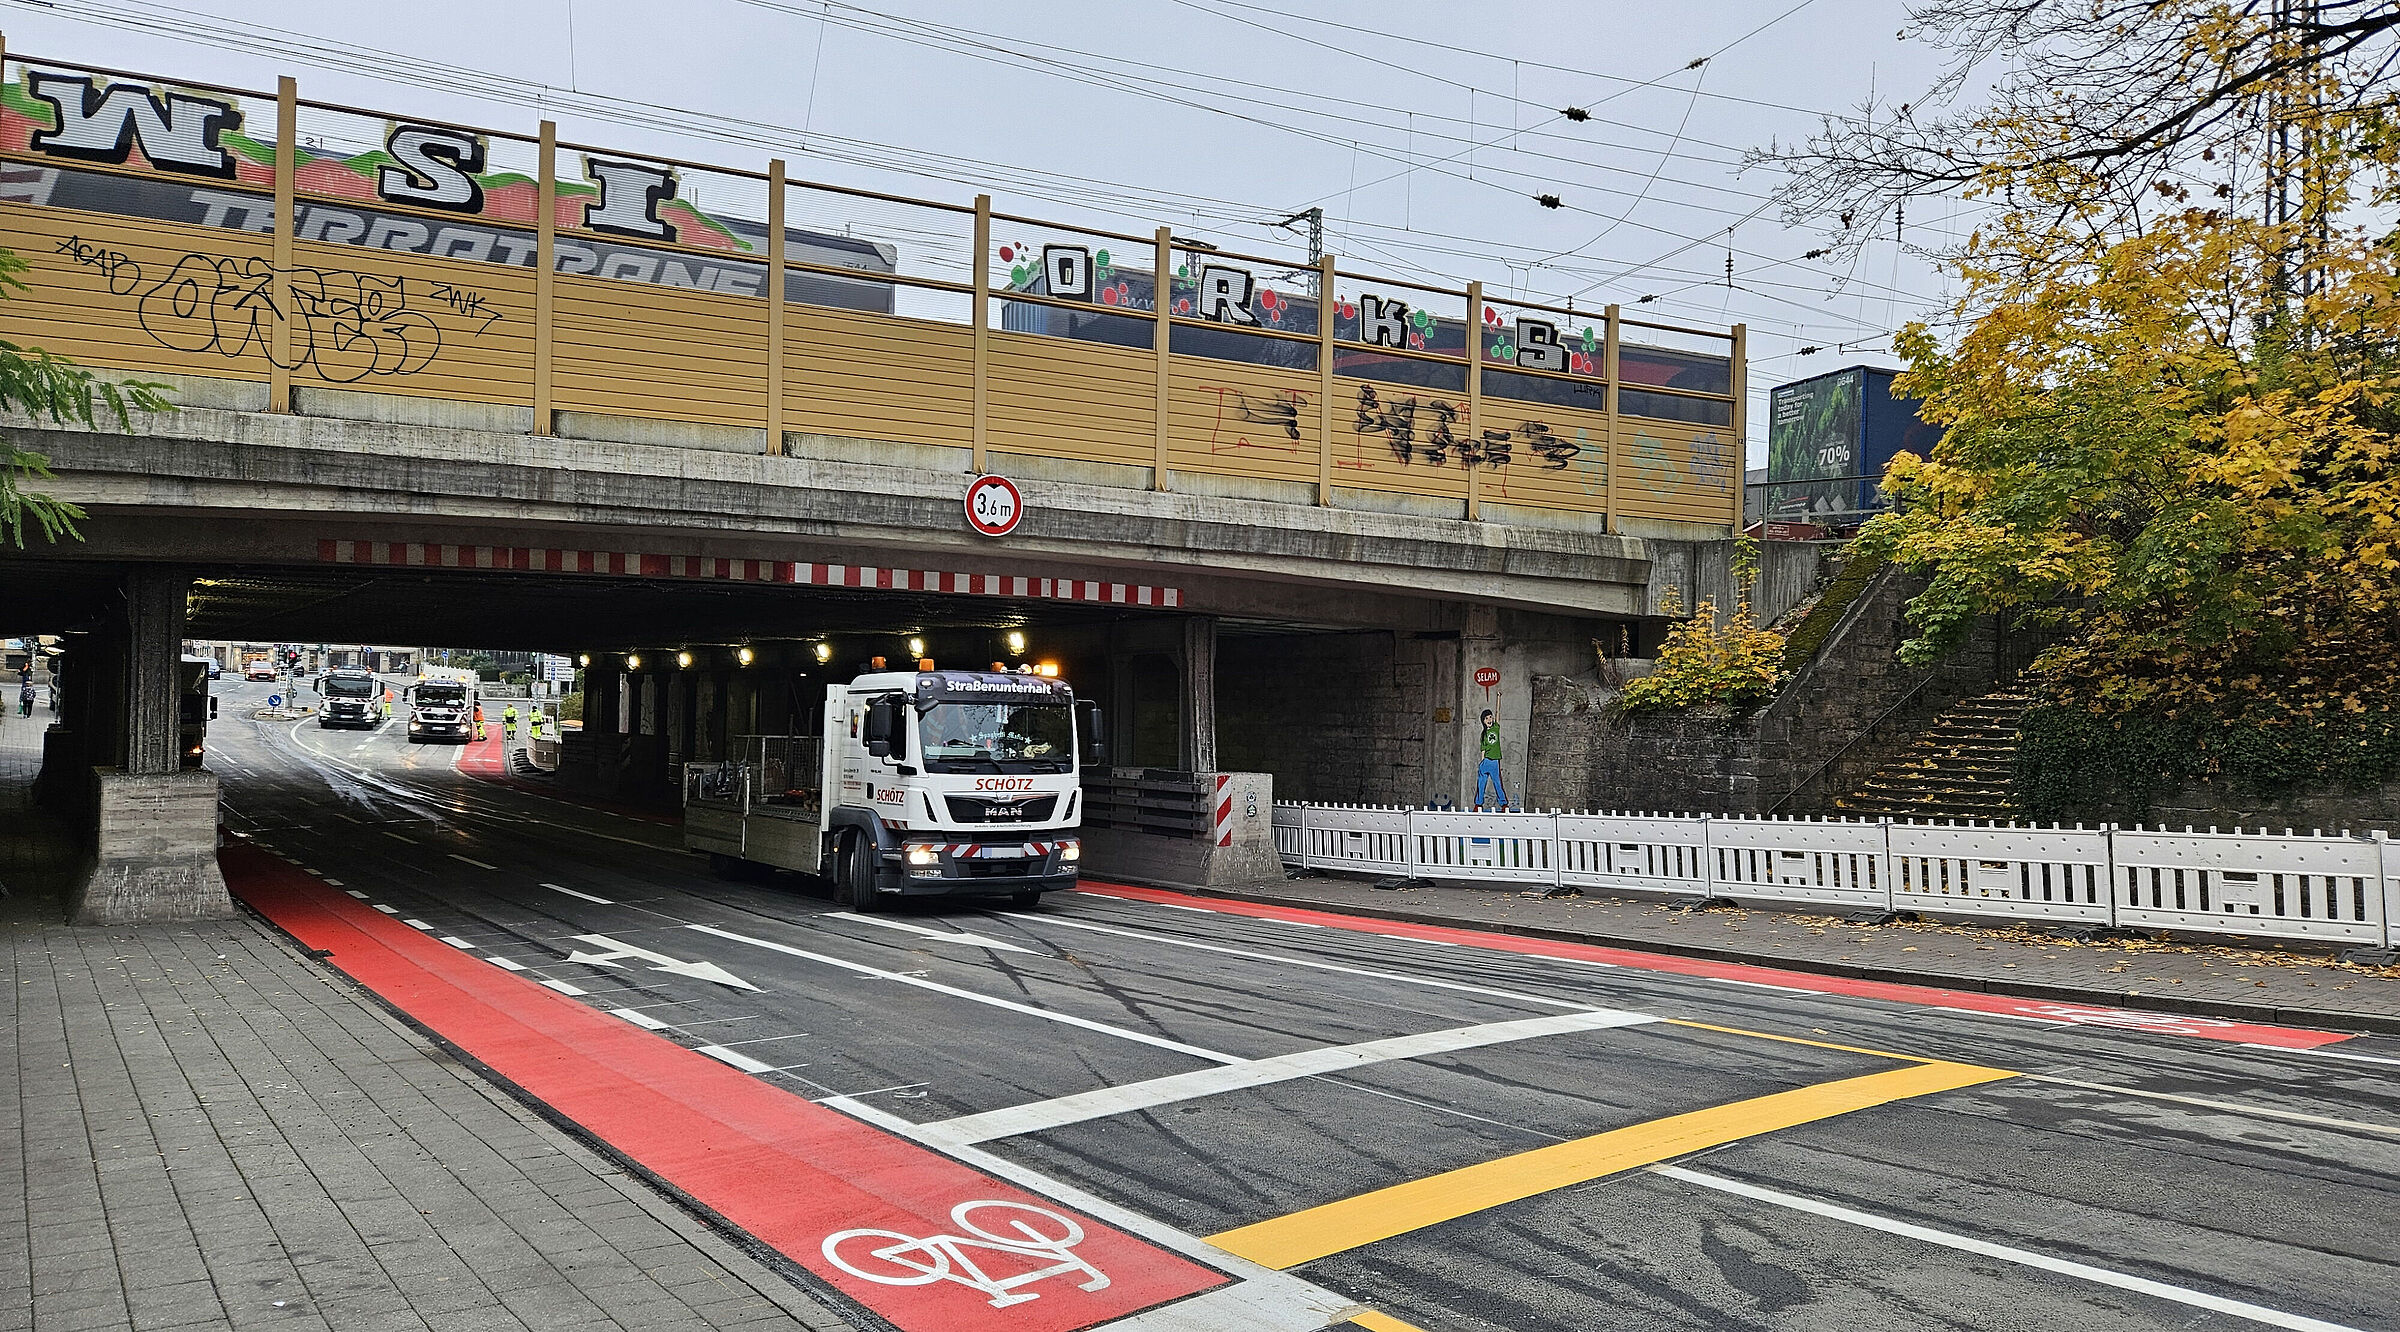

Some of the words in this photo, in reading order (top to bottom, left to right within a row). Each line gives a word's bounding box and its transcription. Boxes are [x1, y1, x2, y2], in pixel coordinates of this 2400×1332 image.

[56, 236, 141, 295] ACAB
[1777, 392, 1815, 406] Transporting
[1777, 403, 1794, 412] today
[1794, 401, 1804, 409] for
[1819, 444, 1850, 466] 70%
[1000, 504, 1011, 517] m
[1477, 671, 1498, 682] SELAM
[946, 680, 1052, 695] Straßenunterhalt
[975, 775, 1034, 791] SCHÖTZ
[876, 786, 905, 804] SCHÖTZ
[984, 807, 1023, 817] MAN
